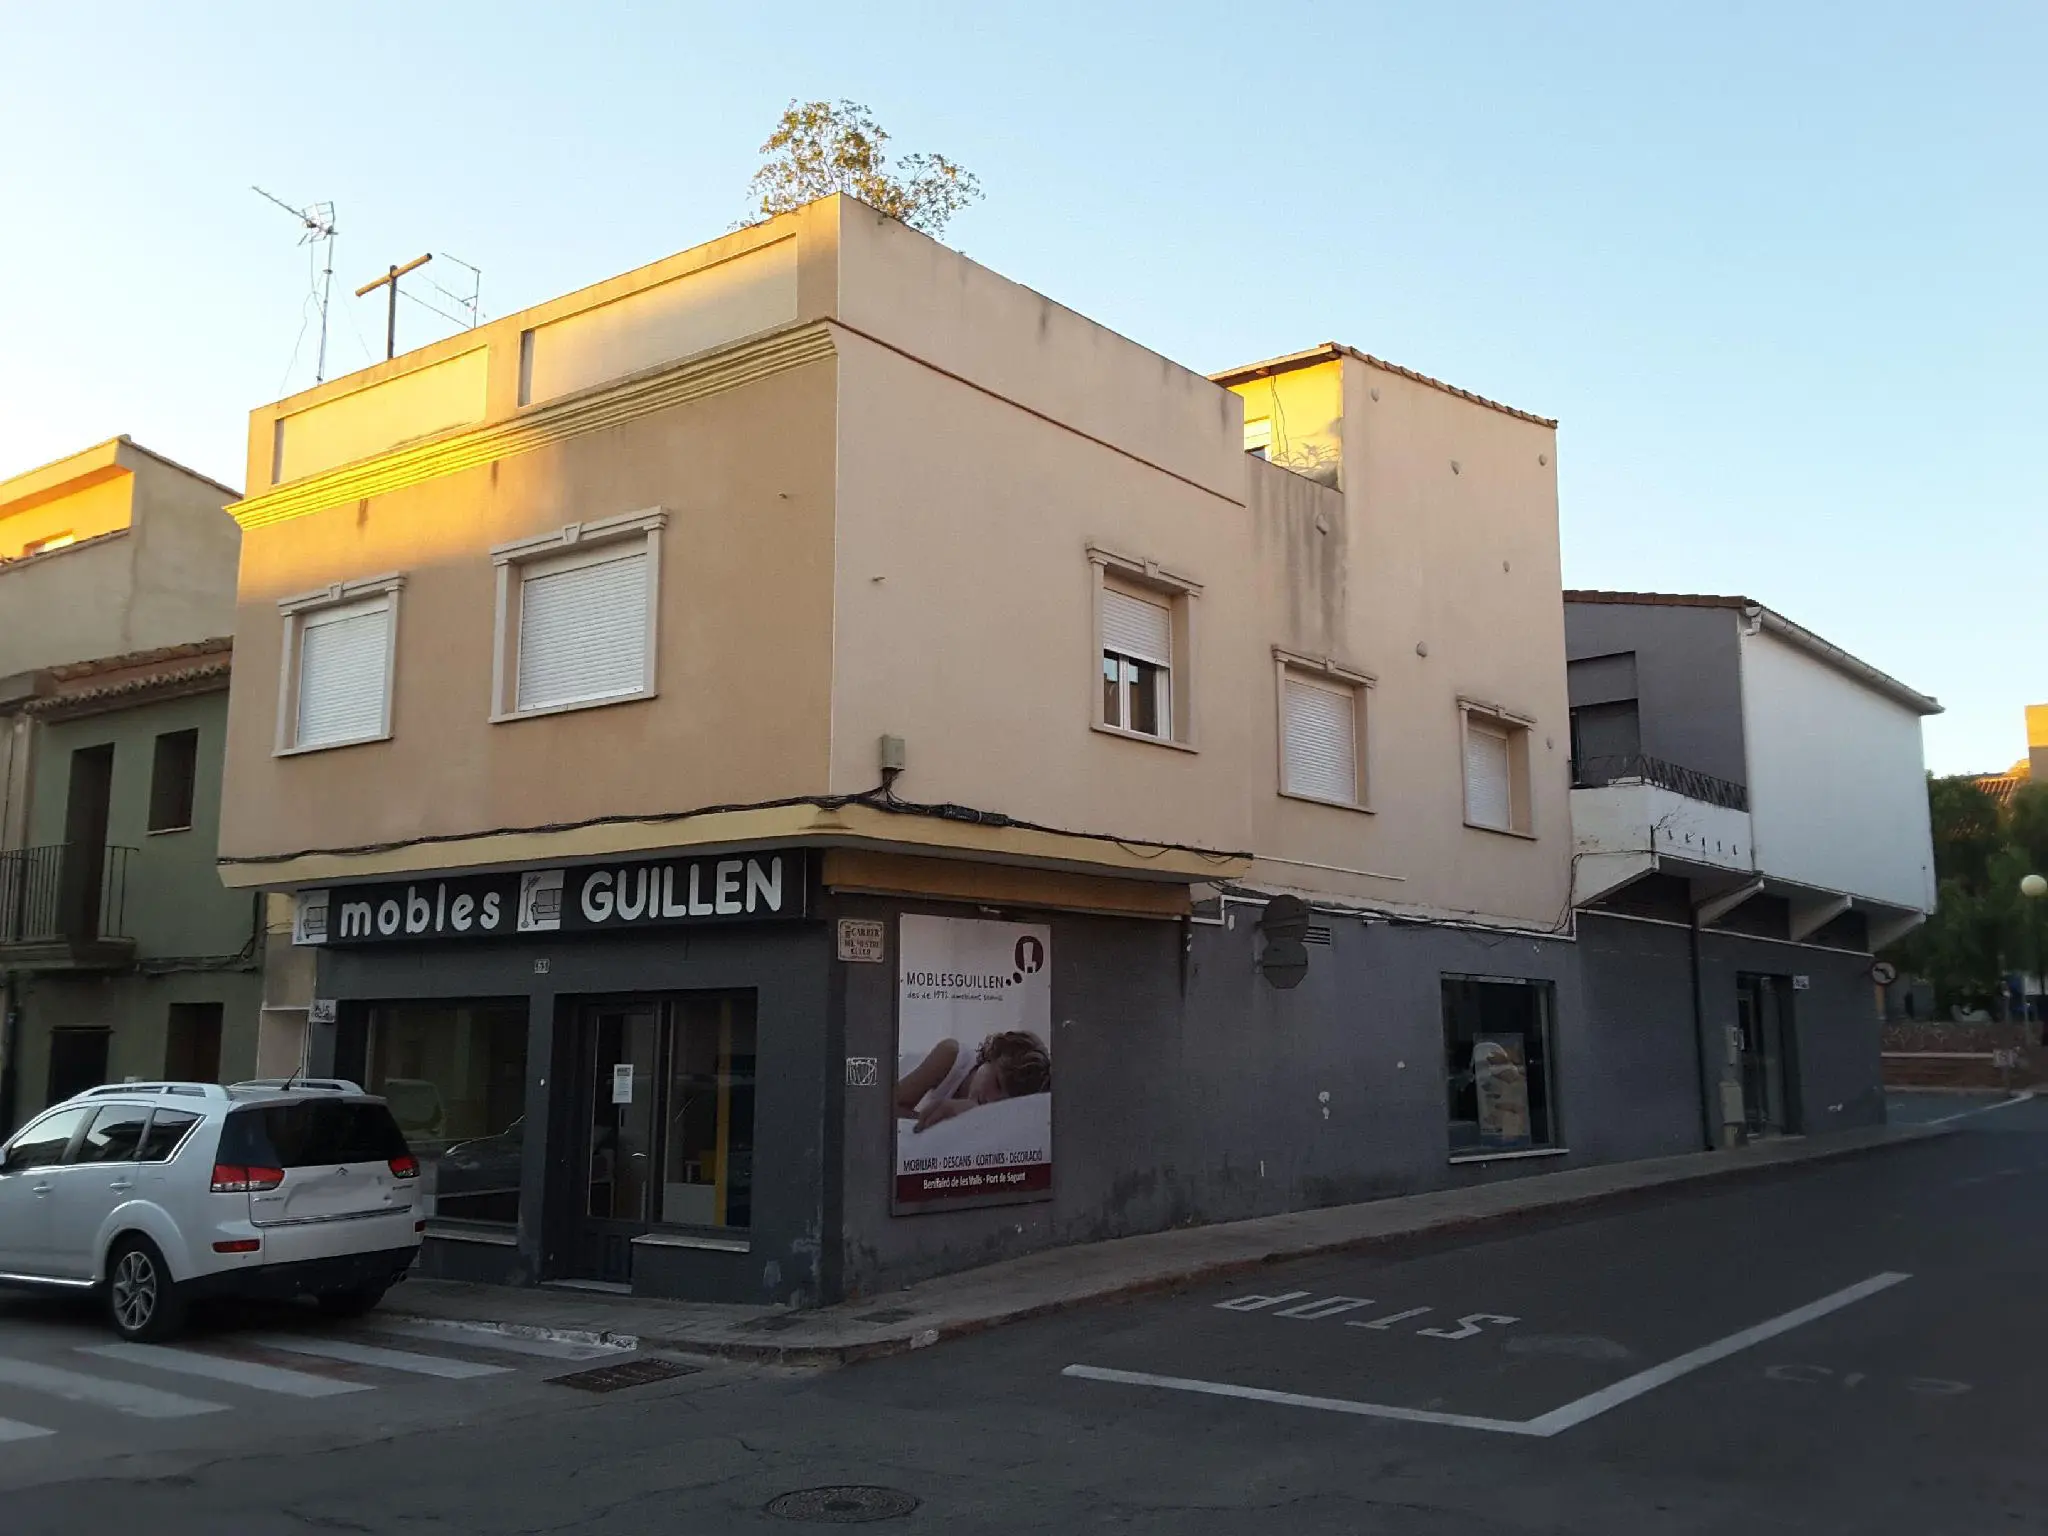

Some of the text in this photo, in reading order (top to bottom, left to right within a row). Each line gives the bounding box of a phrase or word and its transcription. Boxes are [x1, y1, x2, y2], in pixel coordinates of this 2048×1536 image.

[340, 856, 783, 938] mobles GUILLEN
[906, 972, 1004, 989] MOBLESGUILLEN
[943, 1155, 971, 1169] DESCANS
[976, 1153, 1005, 1166] CORTINES
[951, 1177, 959, 1187] de
[986, 1174, 998, 1184] Port
[999, 1173, 1006, 1183] de
[1211, 1290, 1522, 1340] STOP
